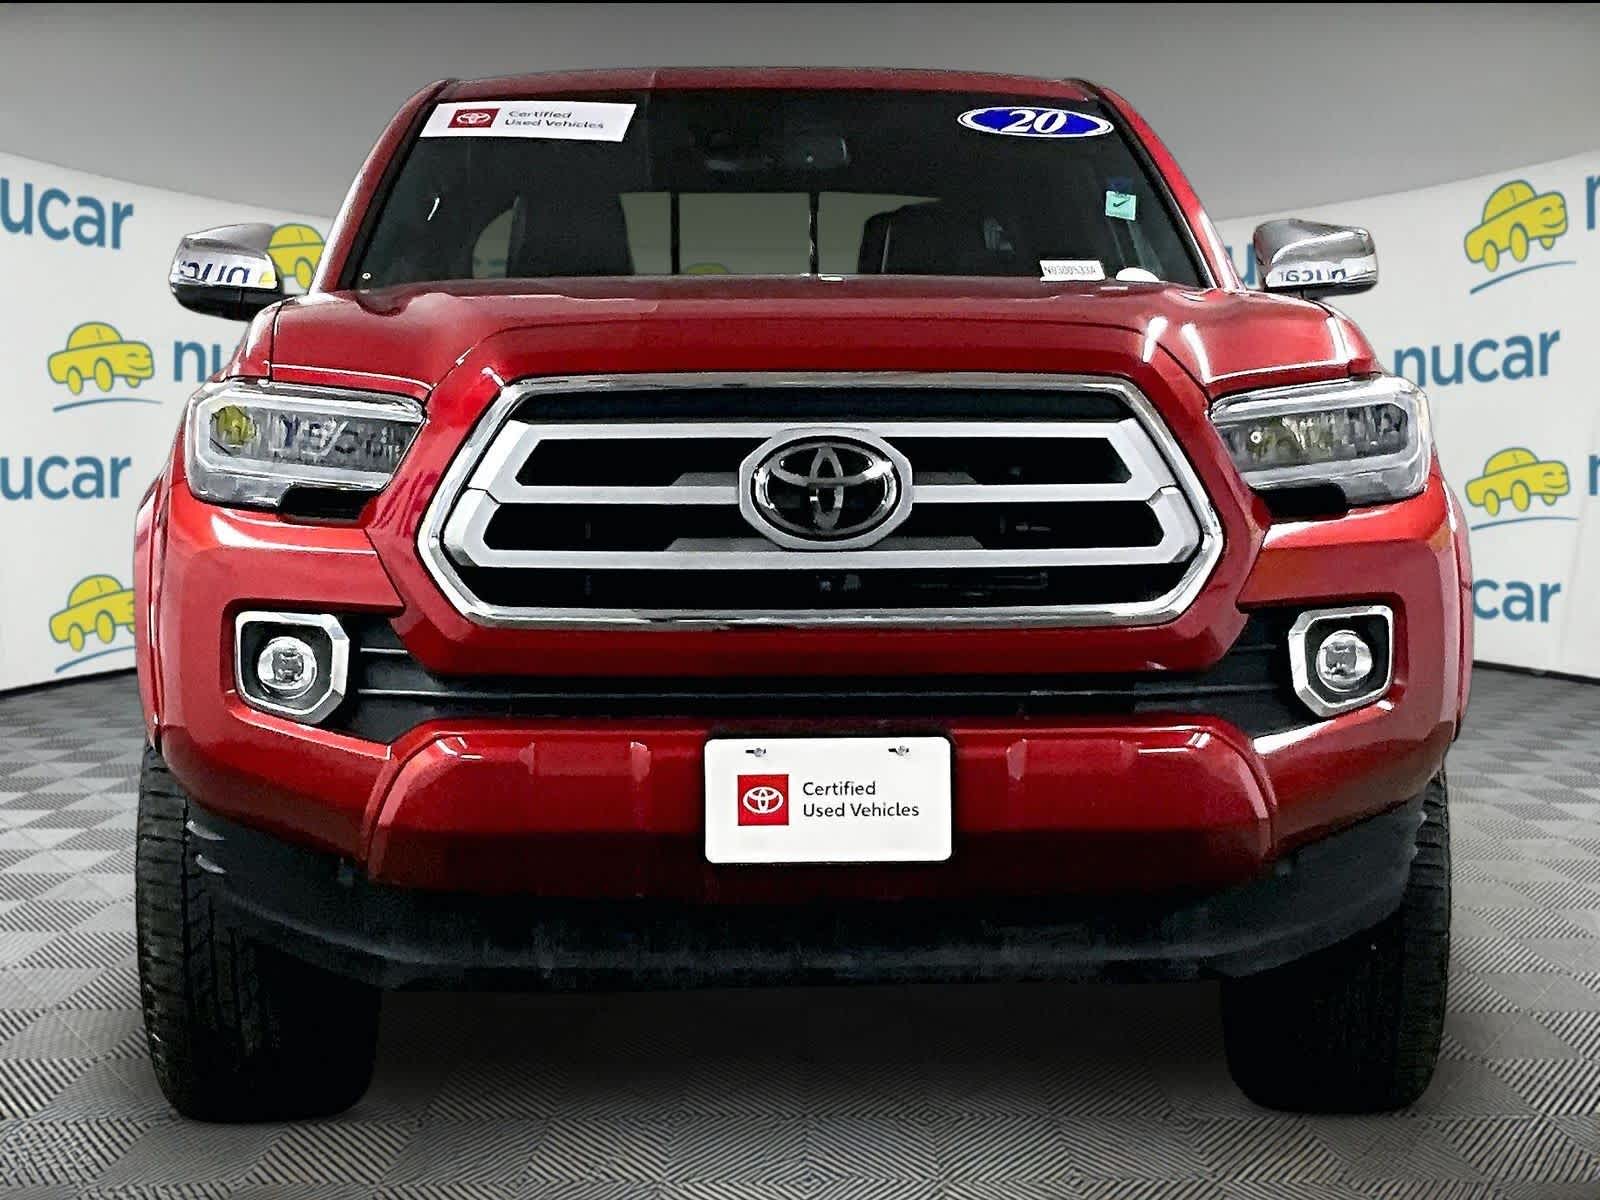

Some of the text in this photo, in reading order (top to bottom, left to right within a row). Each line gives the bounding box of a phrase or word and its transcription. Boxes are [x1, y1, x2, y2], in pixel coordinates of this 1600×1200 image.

[504, 118, 605, 129] Used Vehicles
[507, 109, 574, 119] Certified
[1000, 109, 1068, 134] 20
[1393, 329, 1561, 388] nucar
[0, 455, 132, 501] ucar
[1472, 578, 1563, 624] car
[802, 780, 877, 797] Certified
[802, 801, 920, 818] Used Vehicles
